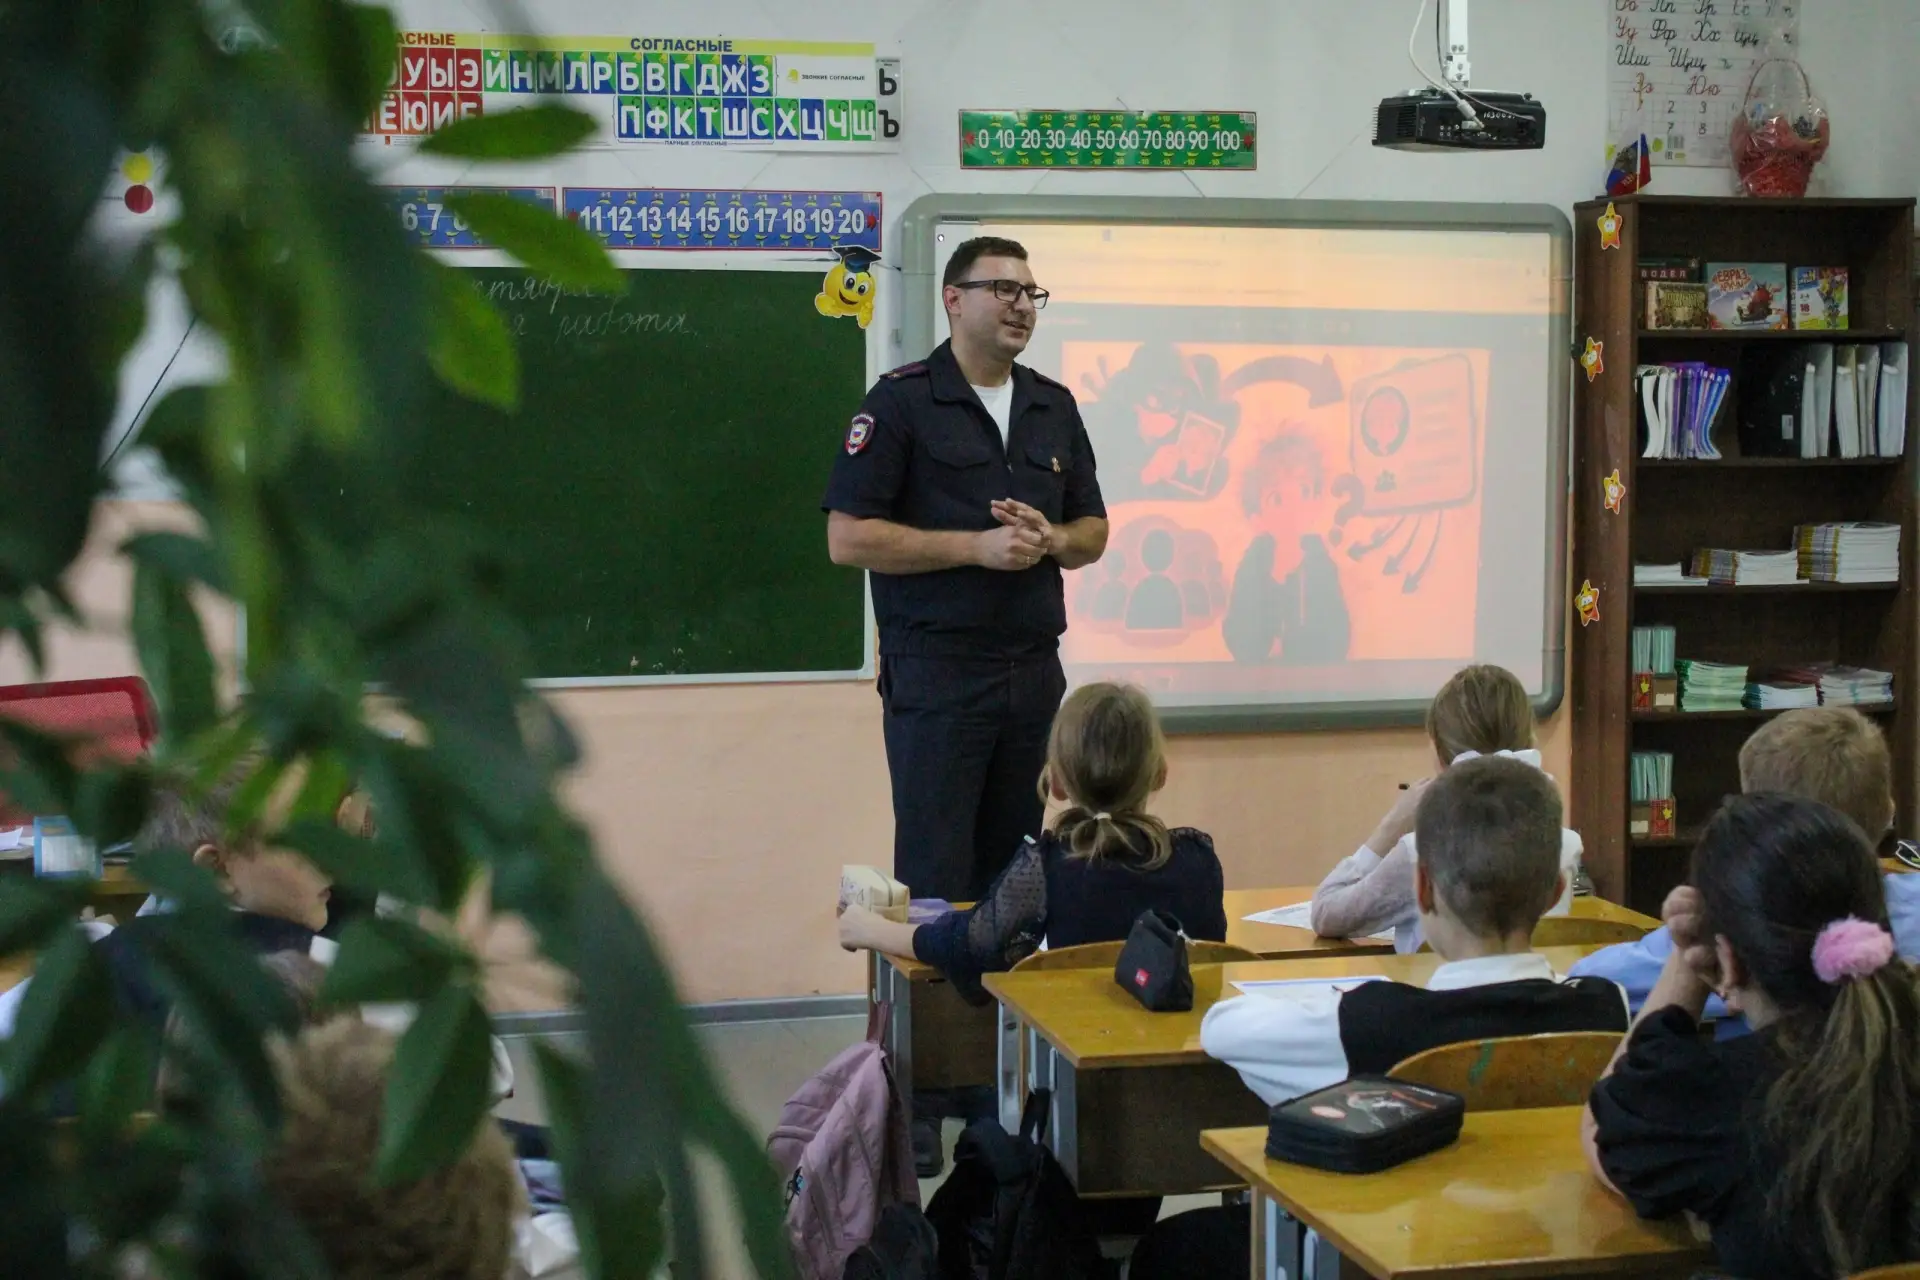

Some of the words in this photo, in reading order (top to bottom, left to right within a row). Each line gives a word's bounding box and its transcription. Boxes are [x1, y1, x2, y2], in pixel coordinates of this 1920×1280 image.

[1691, 20, 1720, 42] Хх
[630, 38, 733, 53] СОГЛАСНЫЕ
[1667, 100, 1675, 113] 2
[978, 129, 989, 149] 0
[995, 129, 1015, 149] 10
[1021, 129, 1041, 149] 20
[1045, 129, 1066, 149] 30
[1070, 129, 1091, 149] 40
[1096, 130, 1115, 150] 50
[1119, 130, 1139, 150] 60
[1143, 130, 1162, 150] 70
[1165, 130, 1185, 150] 80
[1188, 130, 1208, 150] 90
[1212, 130, 1240, 151] 100
[402, 203, 418, 231] 6
[427, 203, 443, 231] 7
[580, 206, 601, 231] 11
[607, 206, 632, 231] 12
[637, 206, 662, 232] 13
[666, 207, 692, 231] 14
[696, 207, 720, 232] 15
[725, 208, 749, 233] 16
[754, 208, 778, 233] 17
[782, 208, 806, 233] 18
[810, 209, 834, 233] 19
[838, 209, 864, 234] 20
